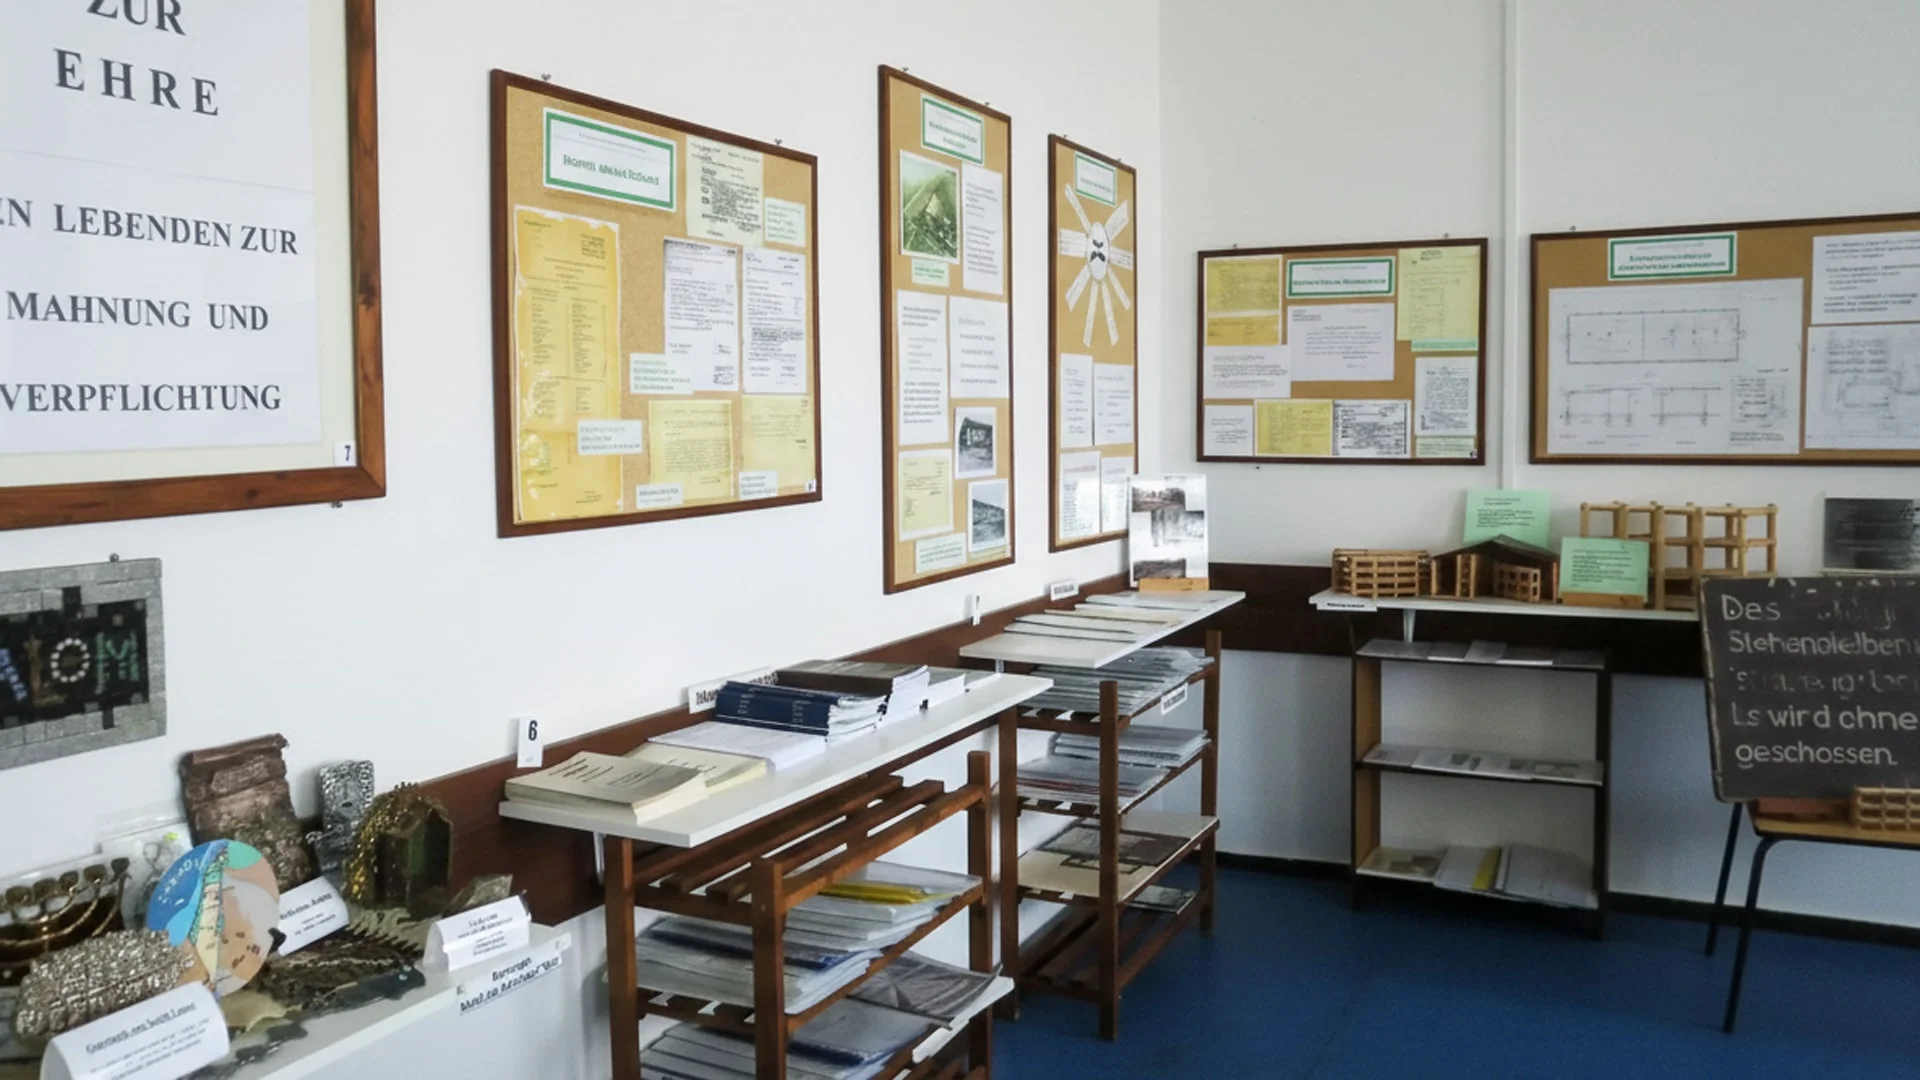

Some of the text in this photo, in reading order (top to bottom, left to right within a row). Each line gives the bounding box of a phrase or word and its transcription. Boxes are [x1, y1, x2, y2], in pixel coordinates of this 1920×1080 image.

[54, 48, 218, 117] EHRE
[0, 197, 298, 255] N LEBENDEN ZUR
[7, 290, 269, 331] MAHNUNG UND
[0, 383, 281, 412] VERPFLICHTUNG
[343, 445, 351, 461] 7
[527, 719, 539, 742] 6
[1767, 704, 1831, 729] wird
